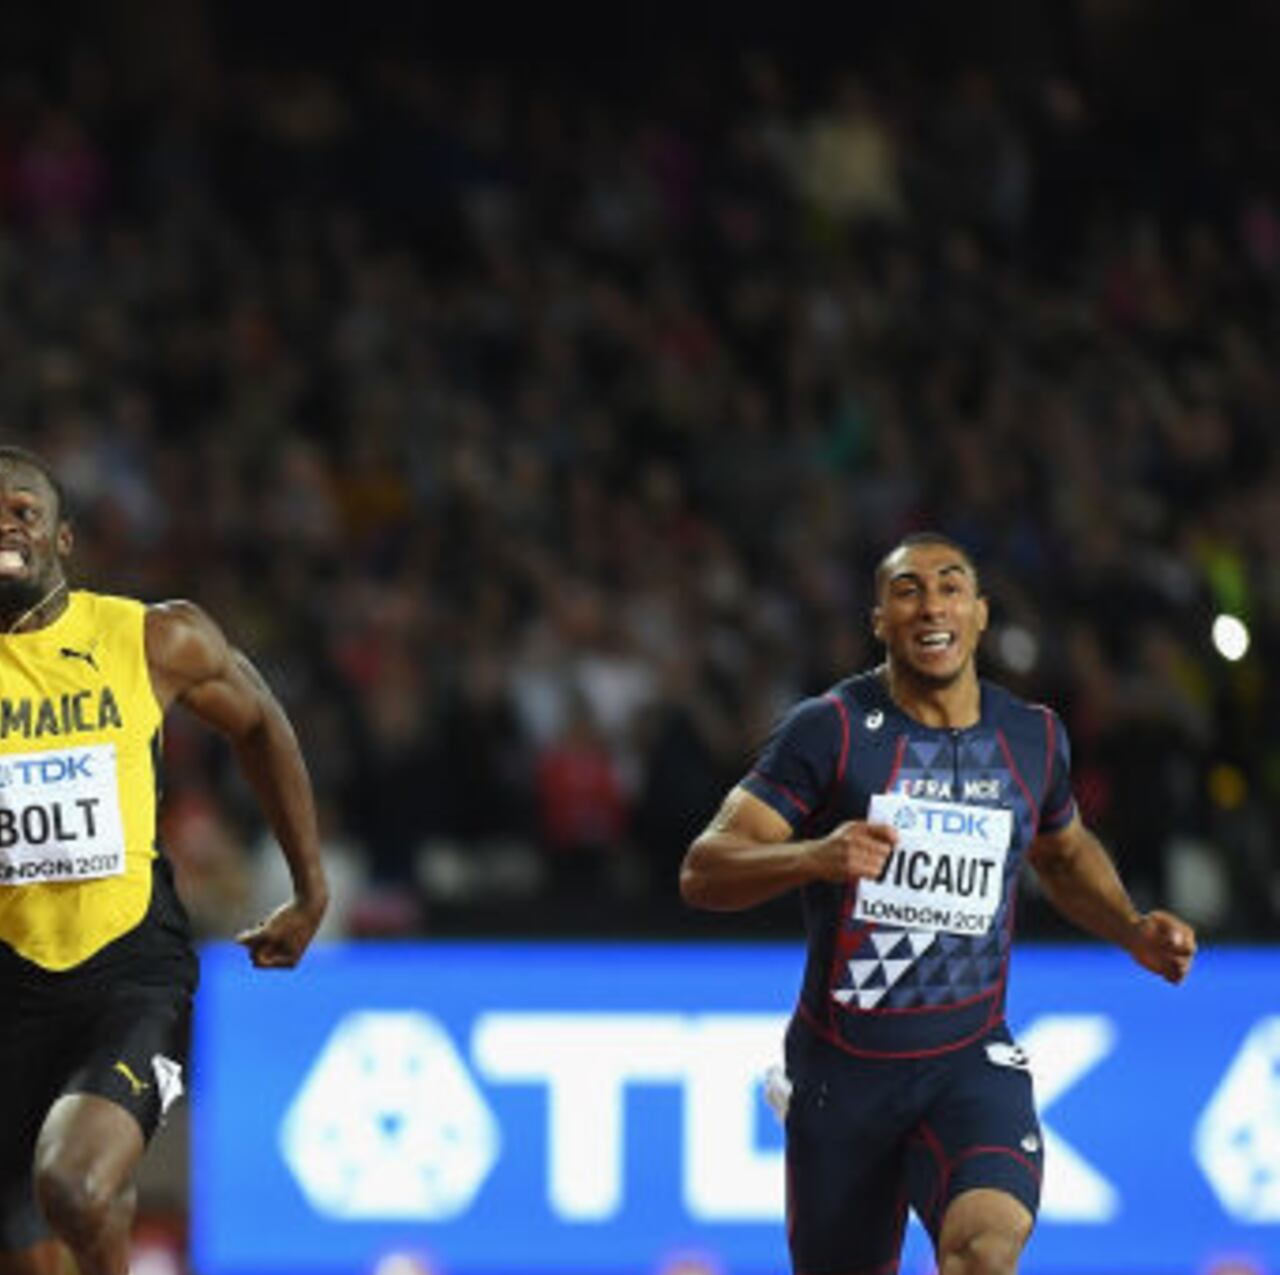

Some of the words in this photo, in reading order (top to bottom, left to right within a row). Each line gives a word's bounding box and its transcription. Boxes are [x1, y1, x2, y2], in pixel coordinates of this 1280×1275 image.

[14, 754, 92, 784] TDK
[920, 808, 990, 838] TDK
[862, 899, 951, 927] LONDON
